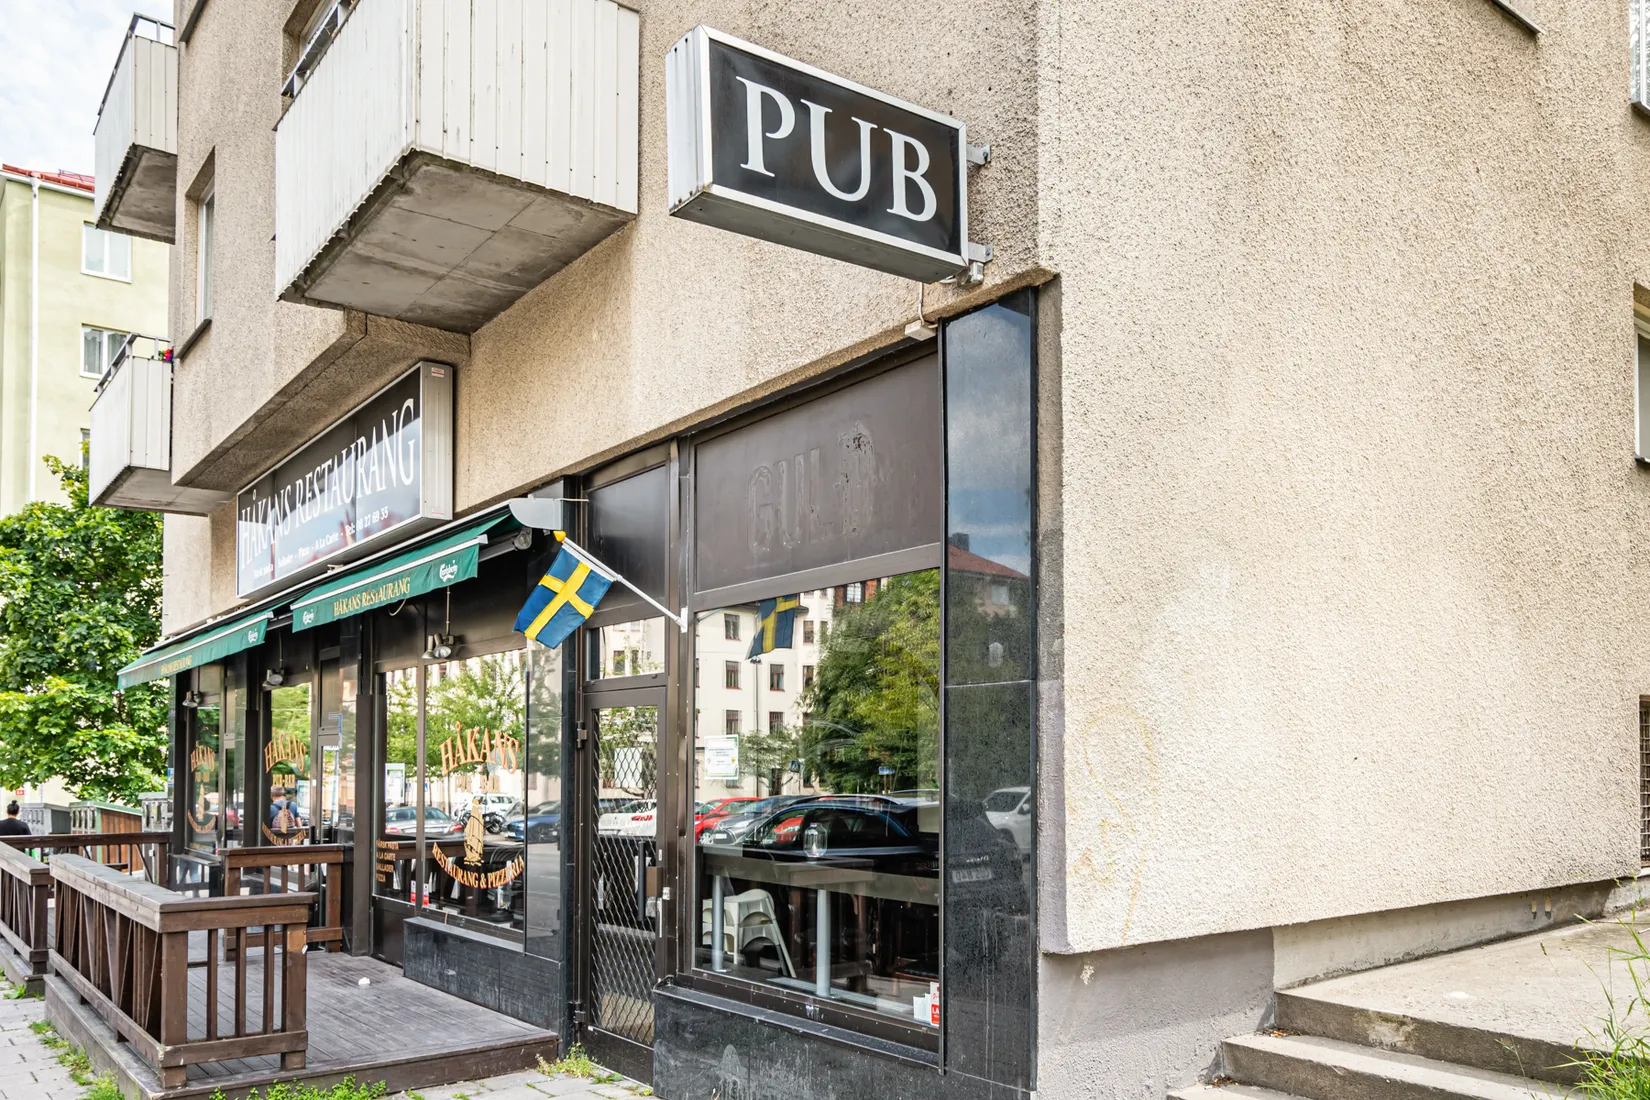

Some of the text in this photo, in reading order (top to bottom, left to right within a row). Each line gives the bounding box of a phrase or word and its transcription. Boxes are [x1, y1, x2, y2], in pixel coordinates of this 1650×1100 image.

[735, 75, 937, 222] PUB
[241, 398, 416, 569] HÅKANS RESTAURANG
[325, 532, 339, 546] Carte
[364, 513, 371, 528] 27
[333, 594, 361, 617] HÅKANS
[263, 726, 307, 774] HÅKANS
[440, 720, 521, 777] HÅKANS
[432, 841, 525, 889] RESTAURANG & PIZZERIA
